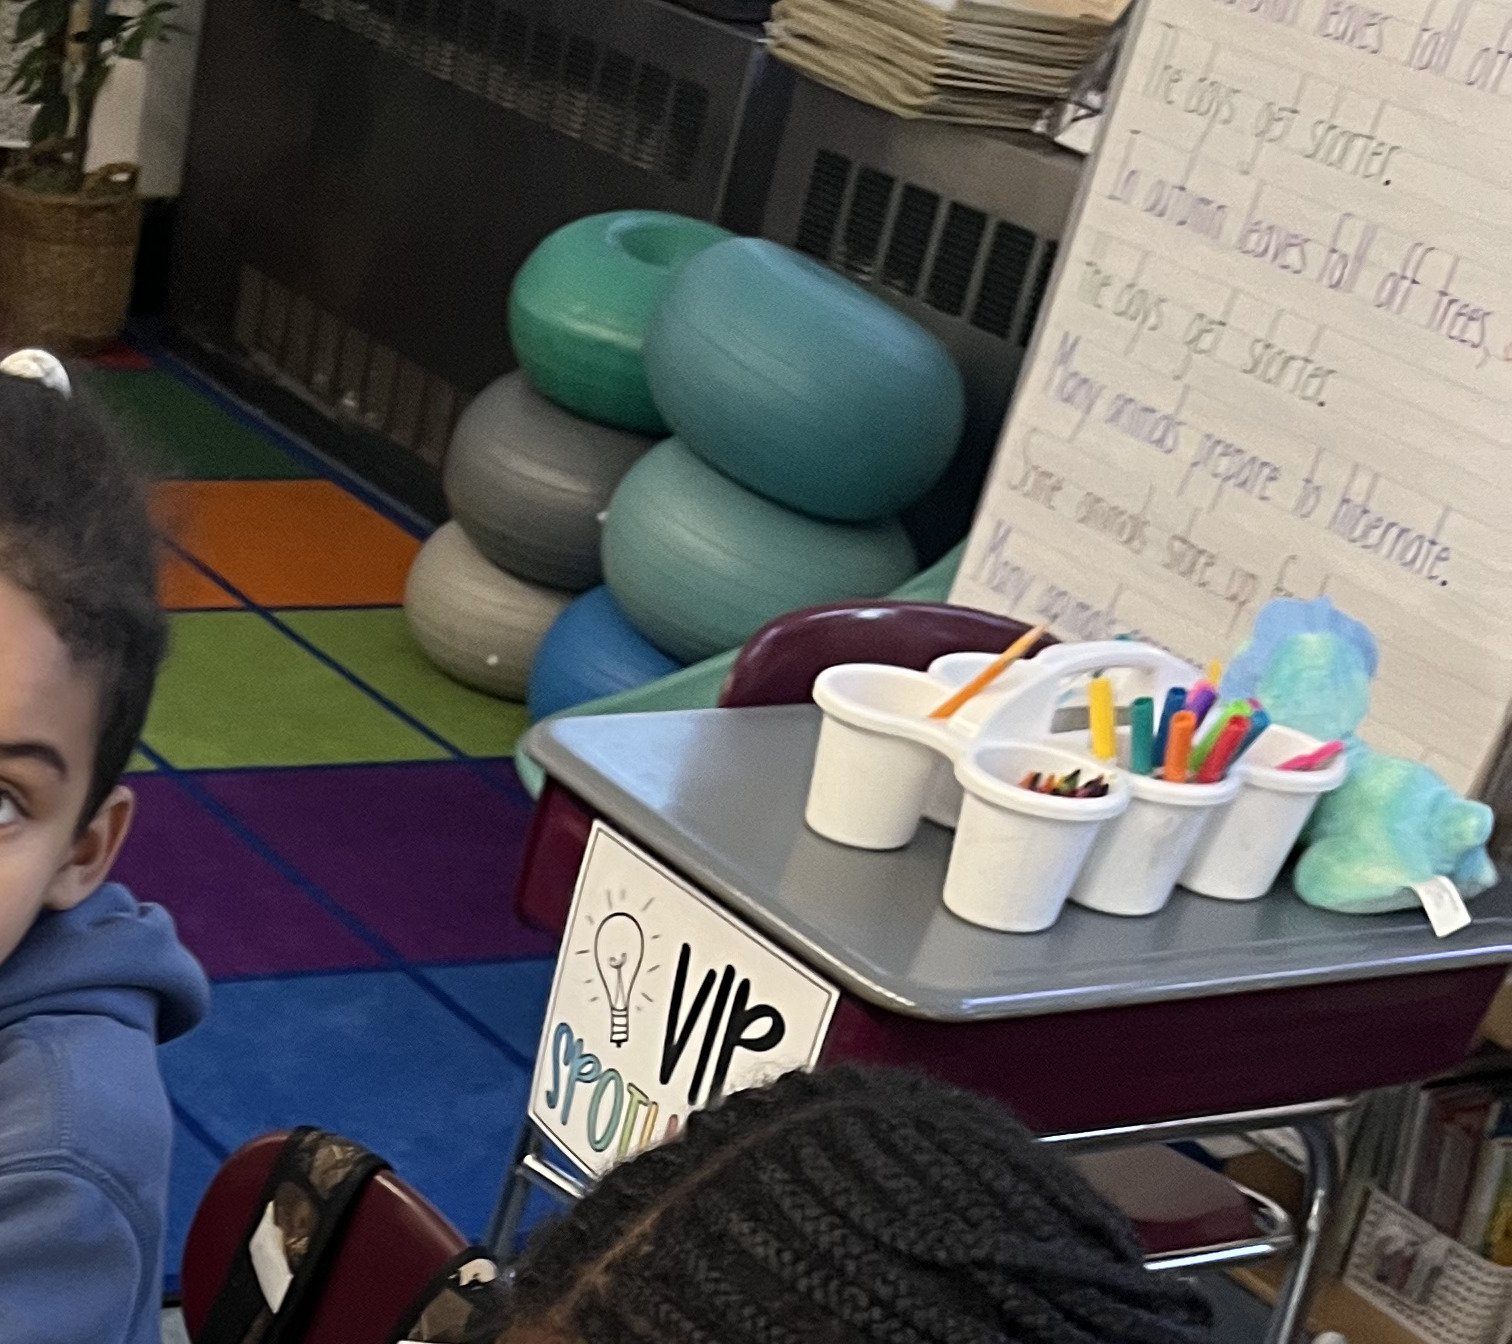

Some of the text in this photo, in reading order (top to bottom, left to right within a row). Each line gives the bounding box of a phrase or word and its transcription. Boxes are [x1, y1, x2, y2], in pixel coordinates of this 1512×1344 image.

[1146, 18, 1402, 187] The days get shorter.
[1107, 129, 1142, 201] In
[1240, 178, 1312, 275] leaves
[1318, 211, 1384, 293] fall
[1375, 242, 1437, 309] off
[1113, 250, 1169, 356] days
[1173, 287, 1238, 380] get
[1243, 308, 1337, 408] shorter.
[1008, 428, 1066, 510] Some
[1047, 329, 1106, 443] Many
[1177, 433, 1282, 514] prepare
[1298, 447, 1325, 519] to
[1327, 462, 1451, 587] hibernate.
[659, 942, 786, 1108] VIP
